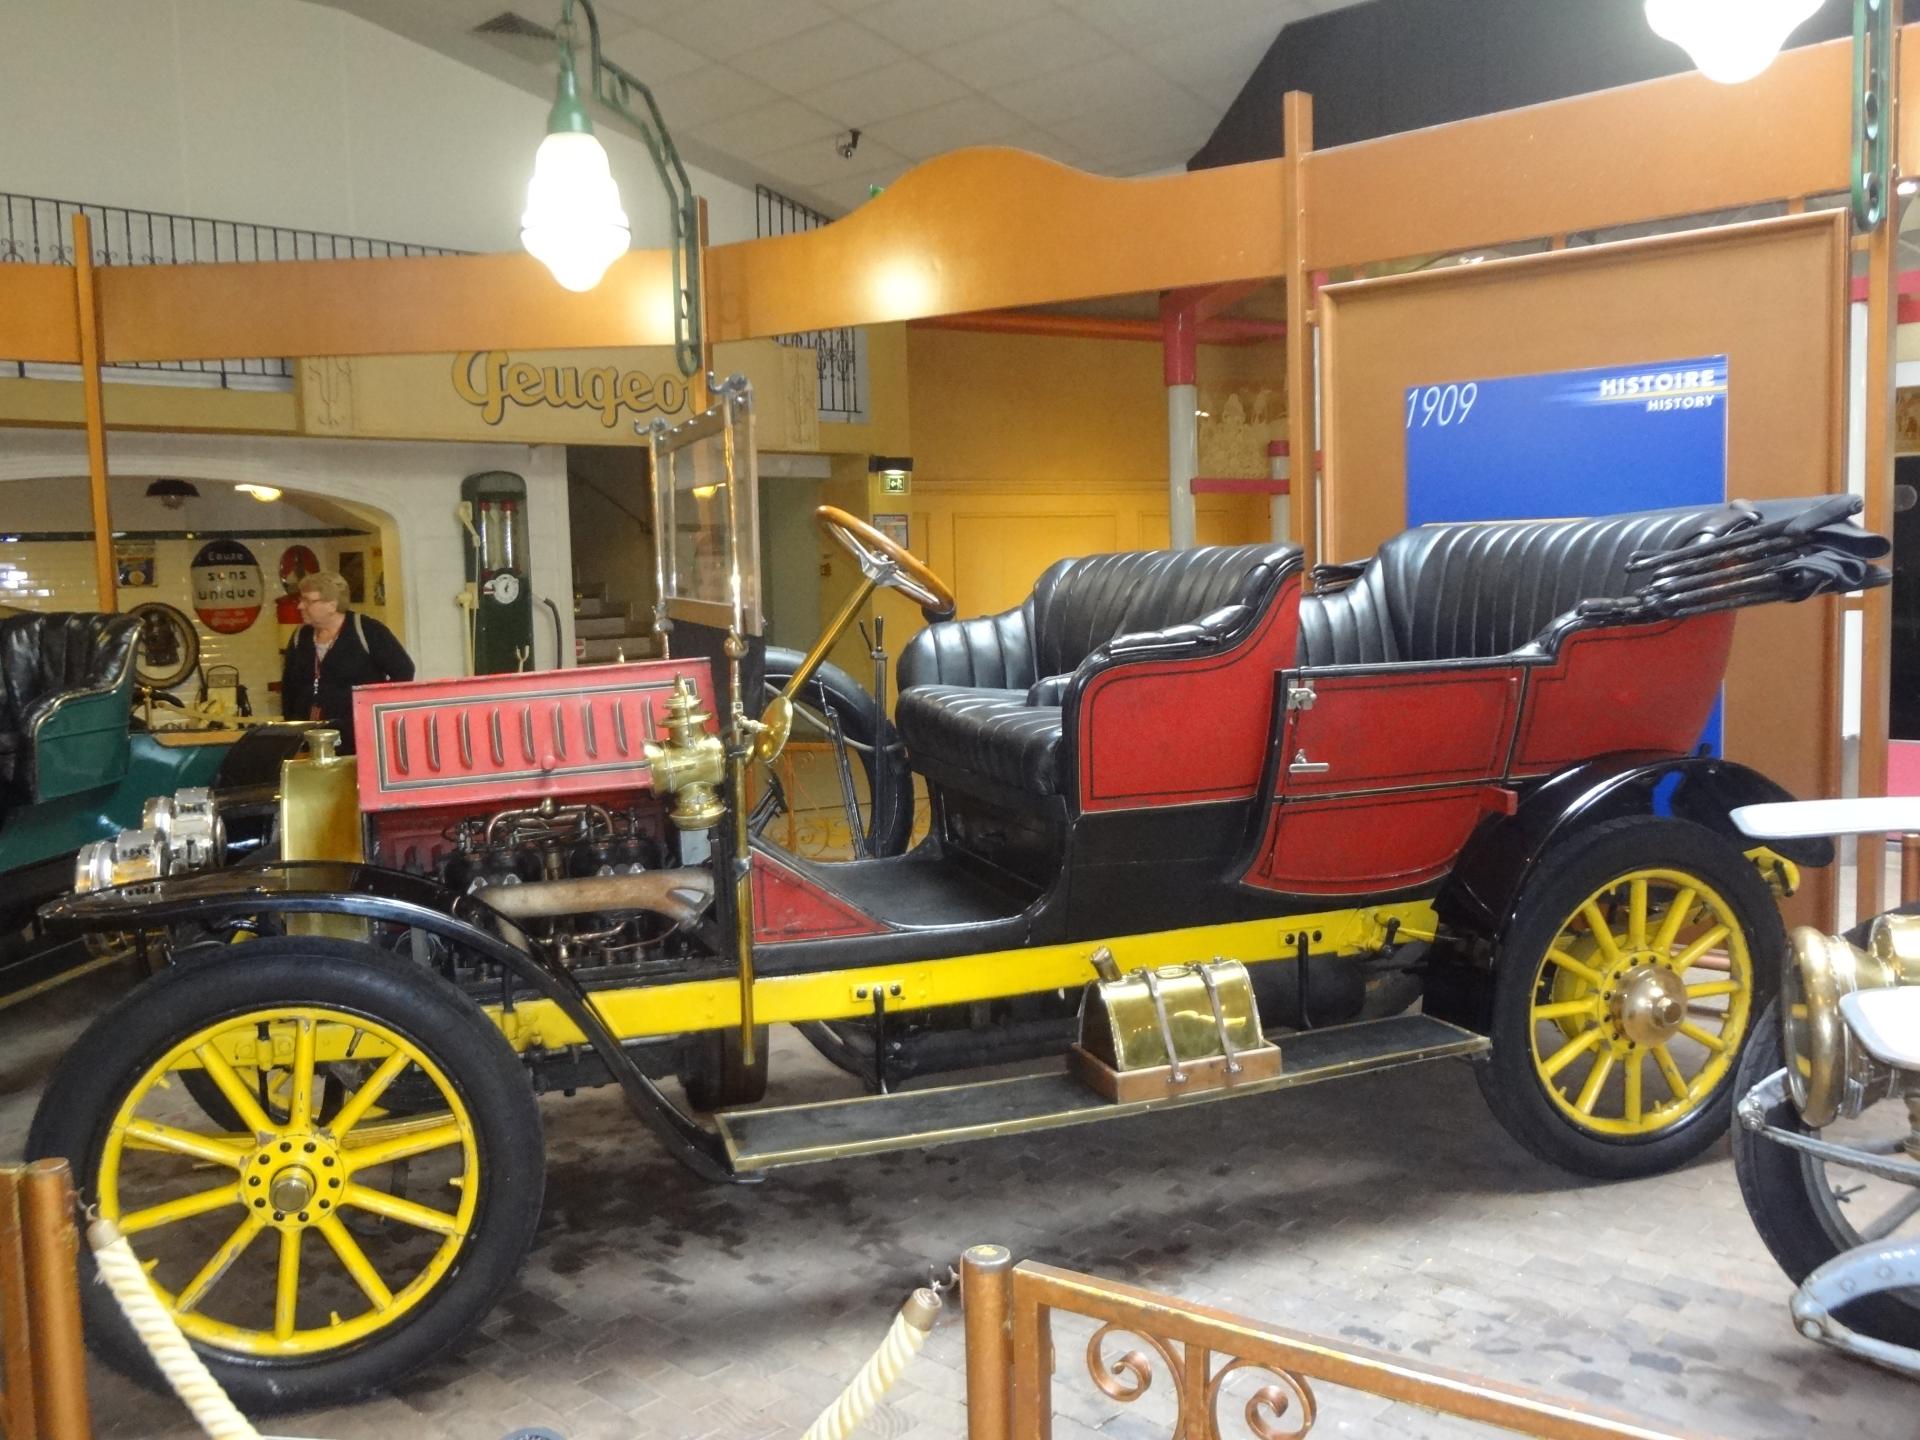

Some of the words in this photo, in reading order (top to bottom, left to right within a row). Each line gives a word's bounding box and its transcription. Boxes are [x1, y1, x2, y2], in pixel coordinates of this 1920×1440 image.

[1600, 369, 1715, 398] HISTOIRE
[1406, 382, 1478, 429] 1909
[1647, 394, 1715, 412] HISTORY
[198, 588, 256, 600] unique
